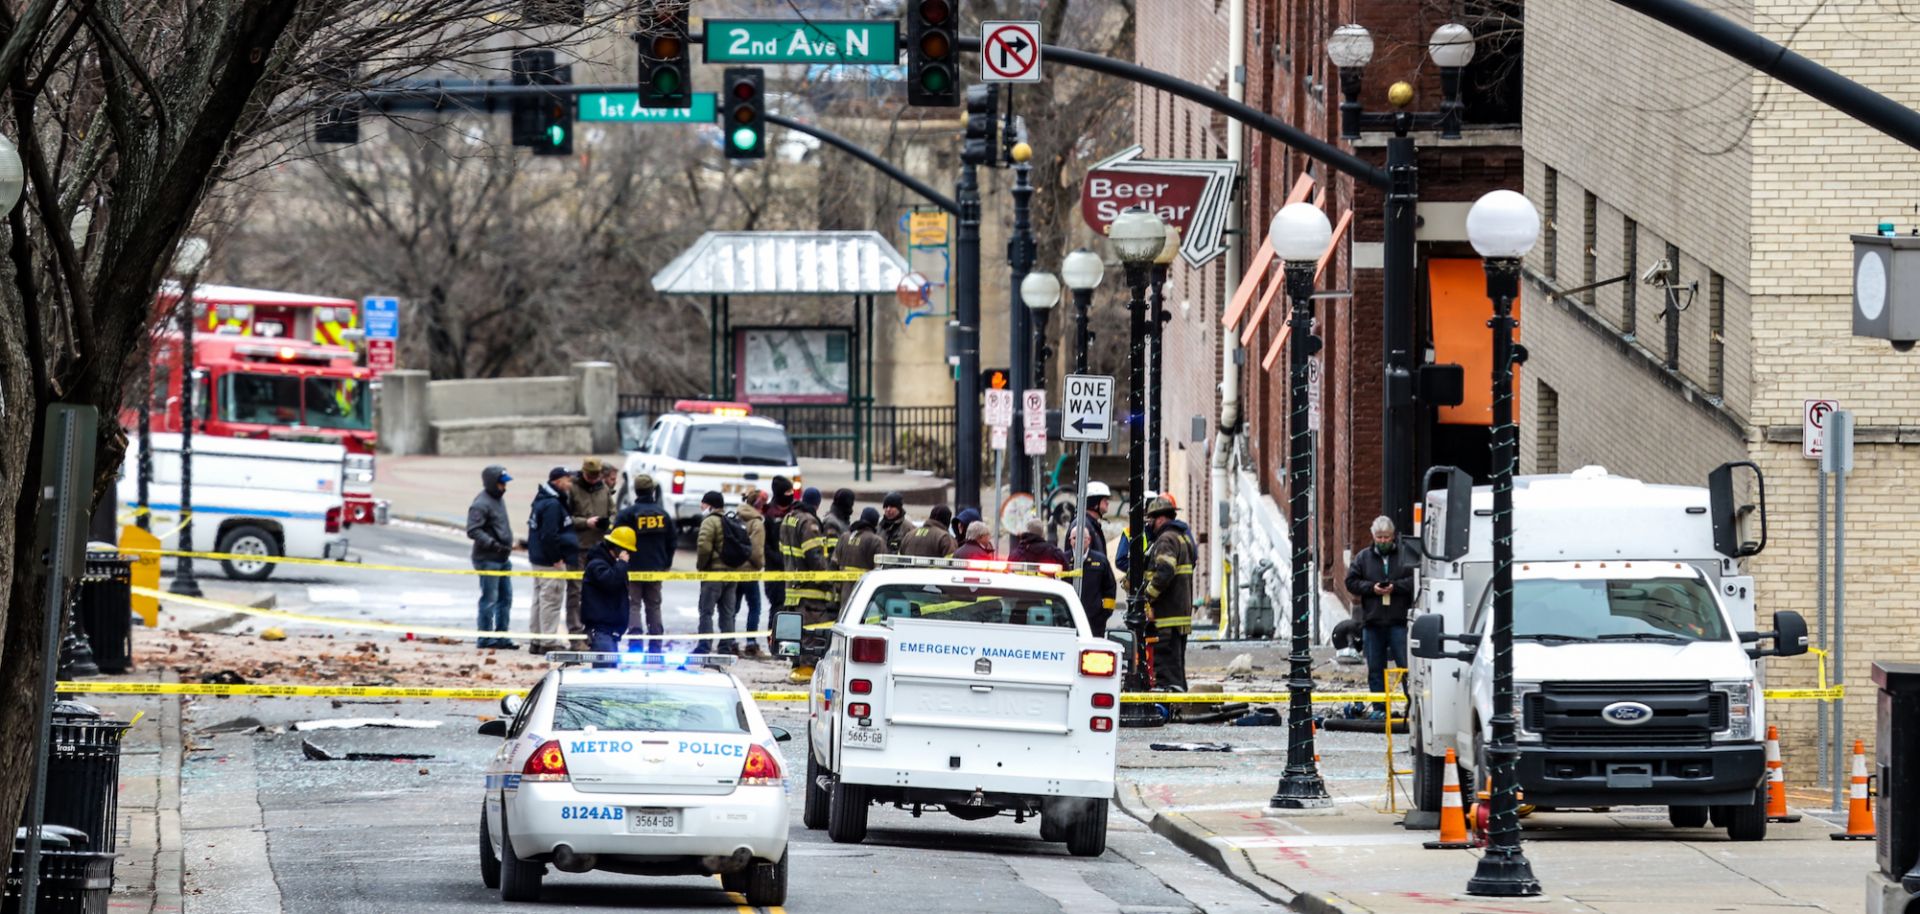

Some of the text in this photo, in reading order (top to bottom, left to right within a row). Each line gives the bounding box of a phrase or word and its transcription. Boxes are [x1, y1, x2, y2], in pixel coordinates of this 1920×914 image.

[729, 28, 869, 56] 2nd Ave N
[599, 96, 624, 117] 1st
[1090, 178, 1169, 198] Beer
[1071, 381, 1106, 397] ONE
[1069, 399, 1107, 415] WAY
[638, 515, 664, 529] FBI
[900, 642, 1065, 661] EMERGENCY MANAGEMENT
[1615, 707, 1641, 719] Ford
[56, 744, 76, 752] Trash
[570, 741, 743, 757] METRO POLICE
[561, 806, 623, 820] 8124AB
[635, 815, 674, 828] 3564-GB
